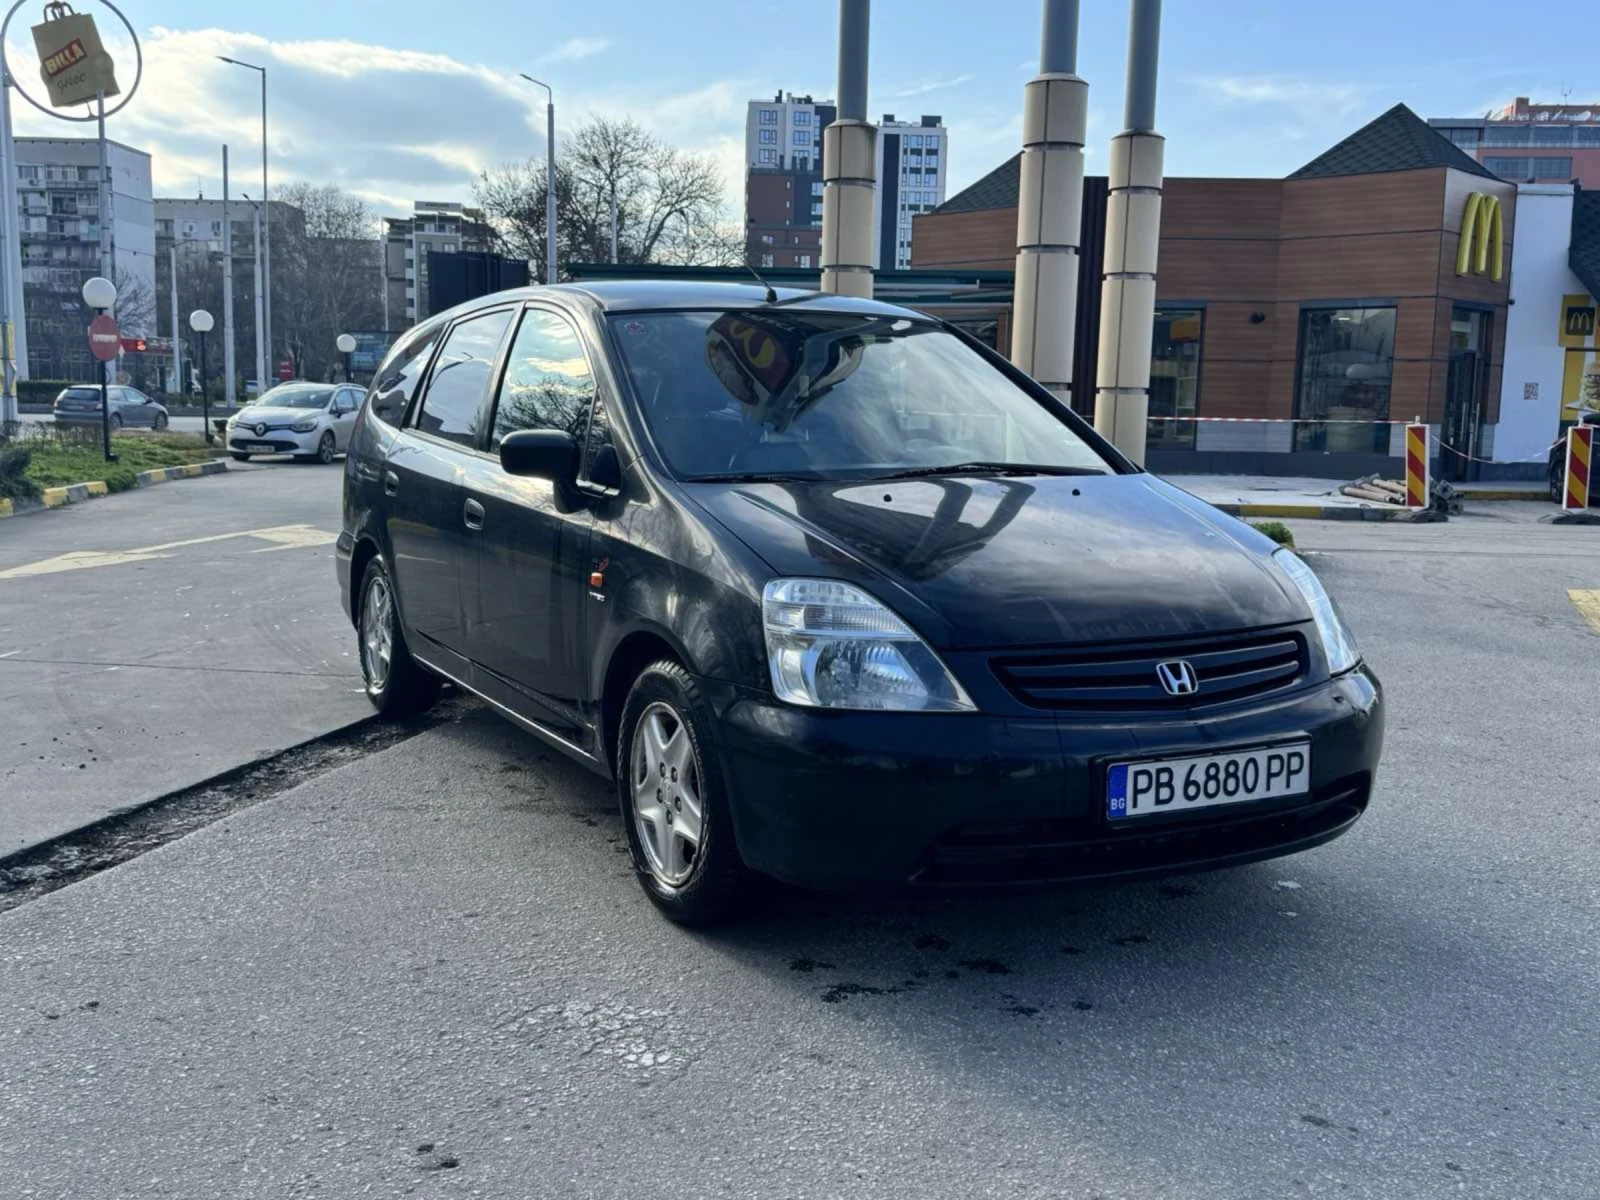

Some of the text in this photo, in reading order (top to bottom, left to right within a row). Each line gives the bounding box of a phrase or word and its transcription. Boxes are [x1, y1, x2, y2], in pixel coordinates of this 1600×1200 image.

[45, 43, 85, 74] BILLA
[1132, 751, 1305, 809] PB 6880 PP
[1110, 798, 1125, 811] BG
